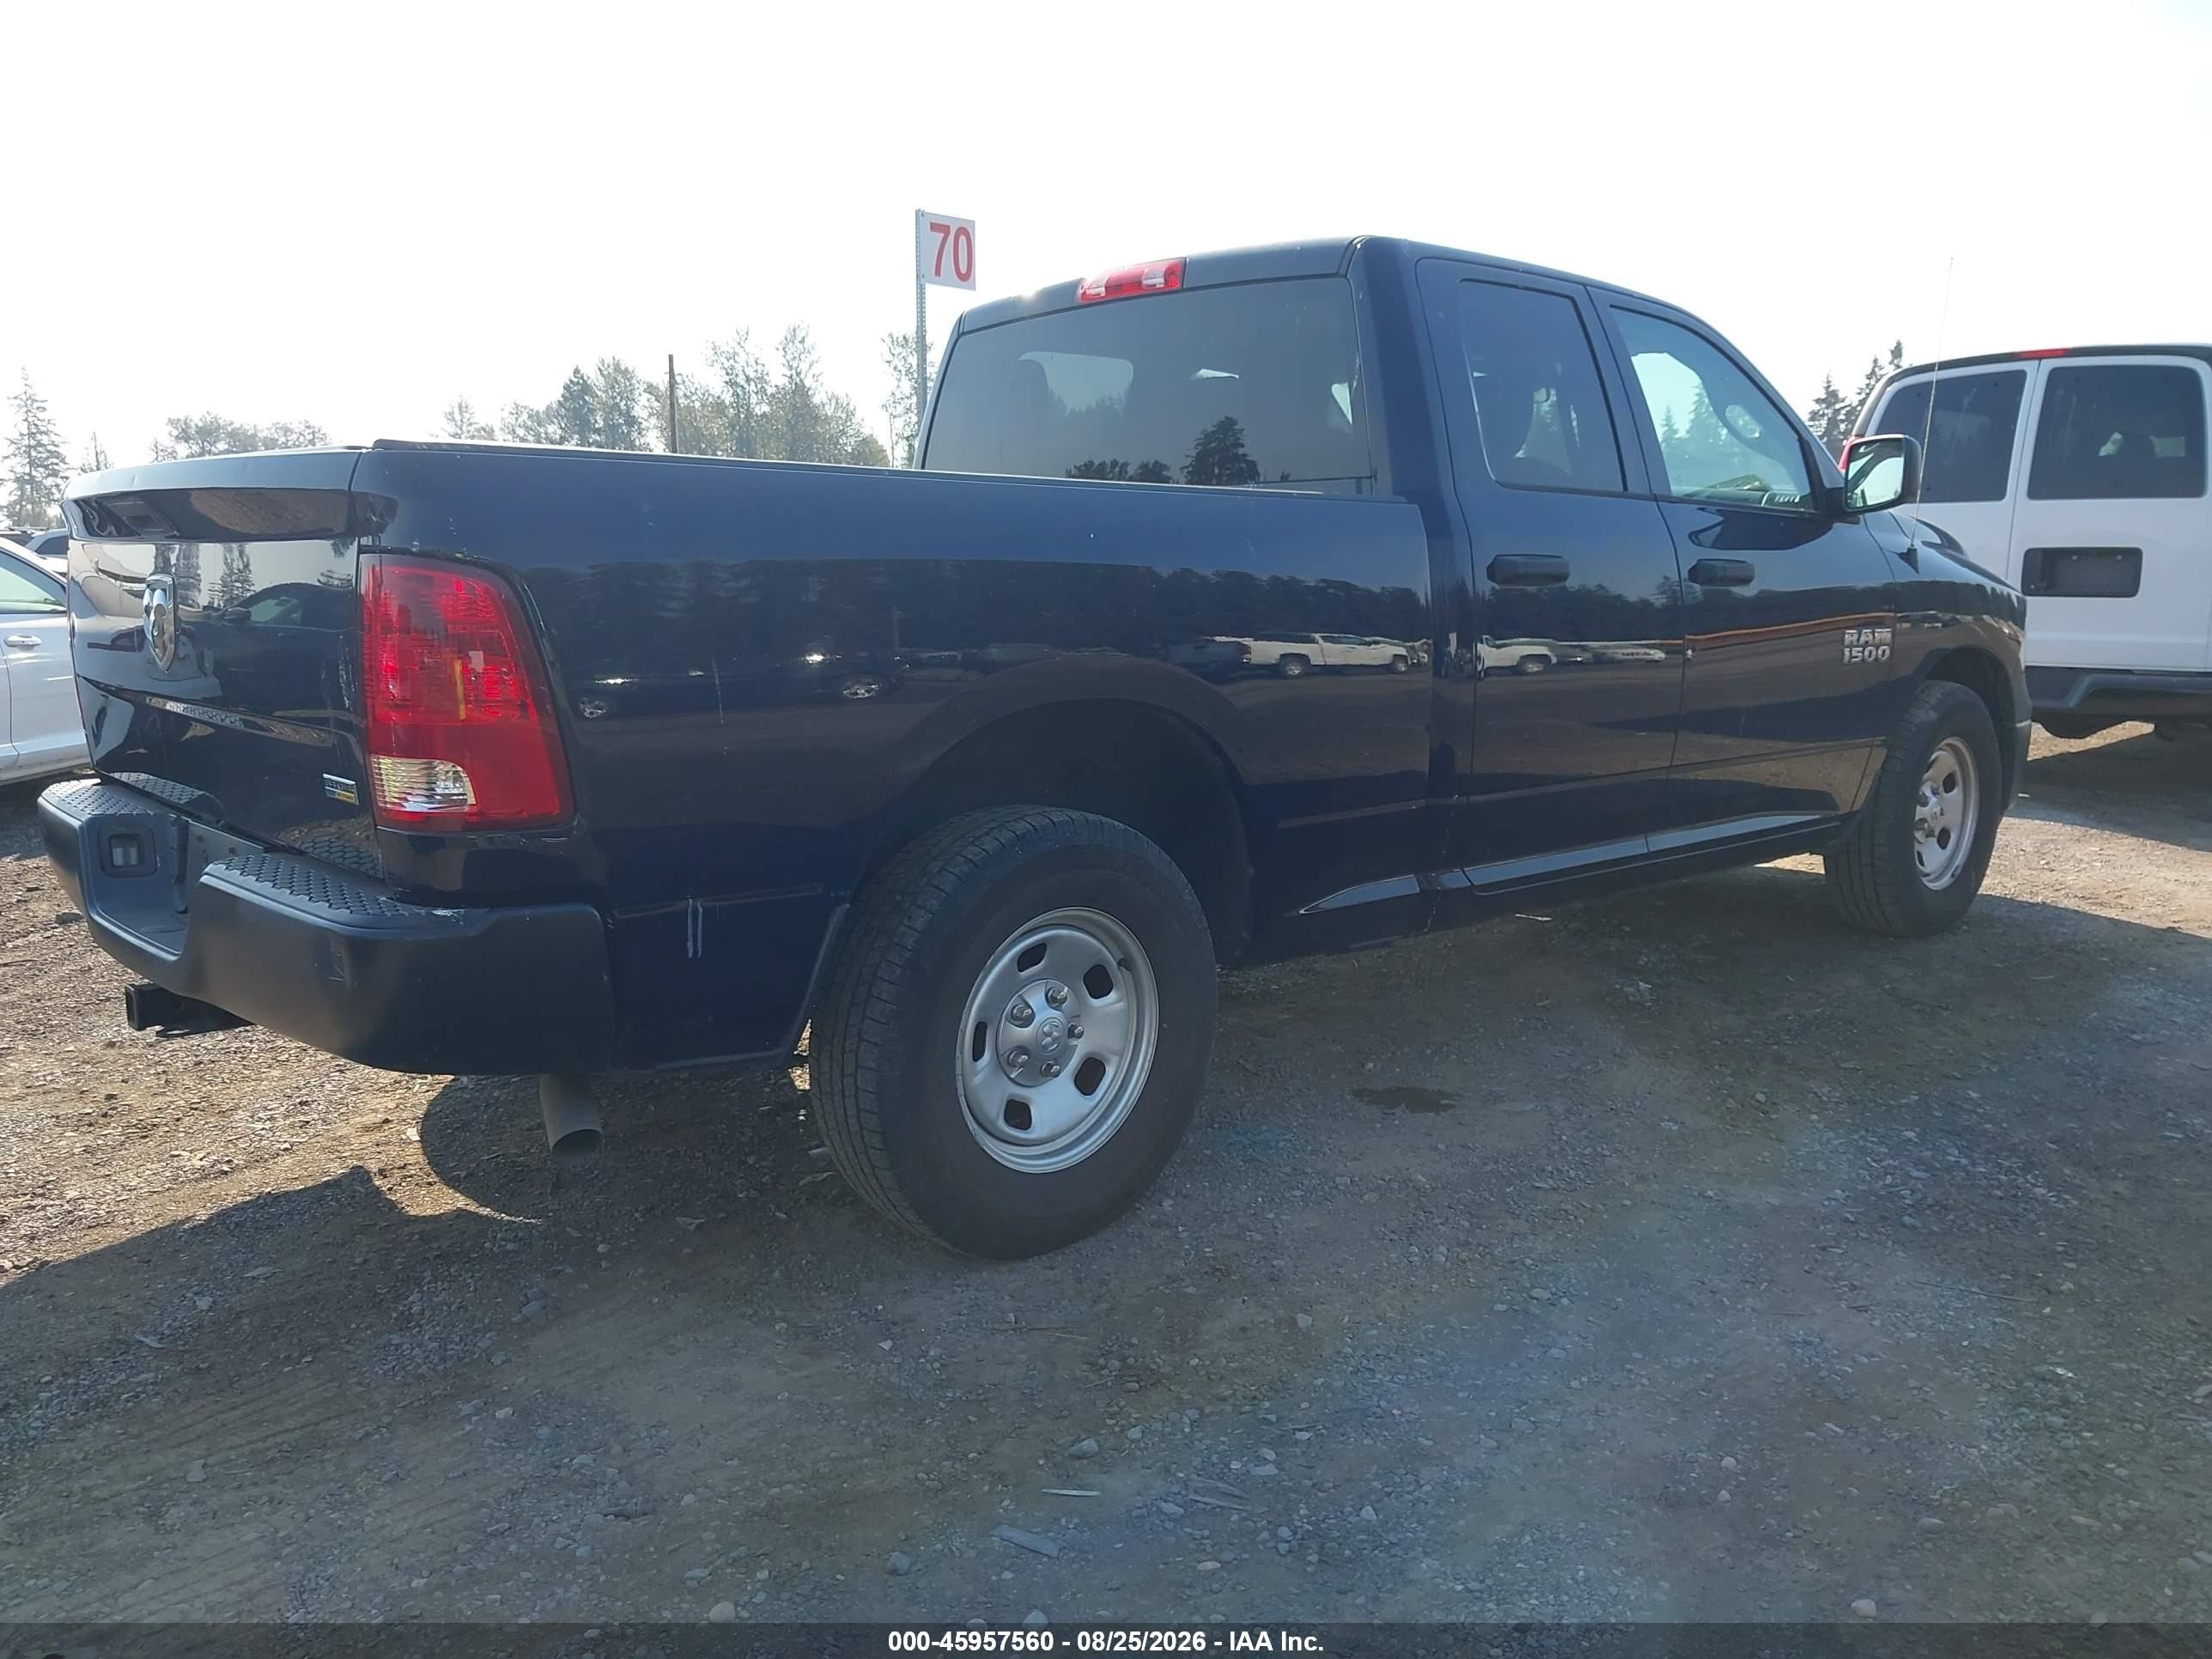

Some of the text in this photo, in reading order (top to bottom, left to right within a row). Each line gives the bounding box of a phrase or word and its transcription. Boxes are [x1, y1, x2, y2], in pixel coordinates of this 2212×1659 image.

[930, 222, 973, 283] 70
[1844, 628, 1892, 646] RAM
[1843, 646, 1890, 663] 1500
